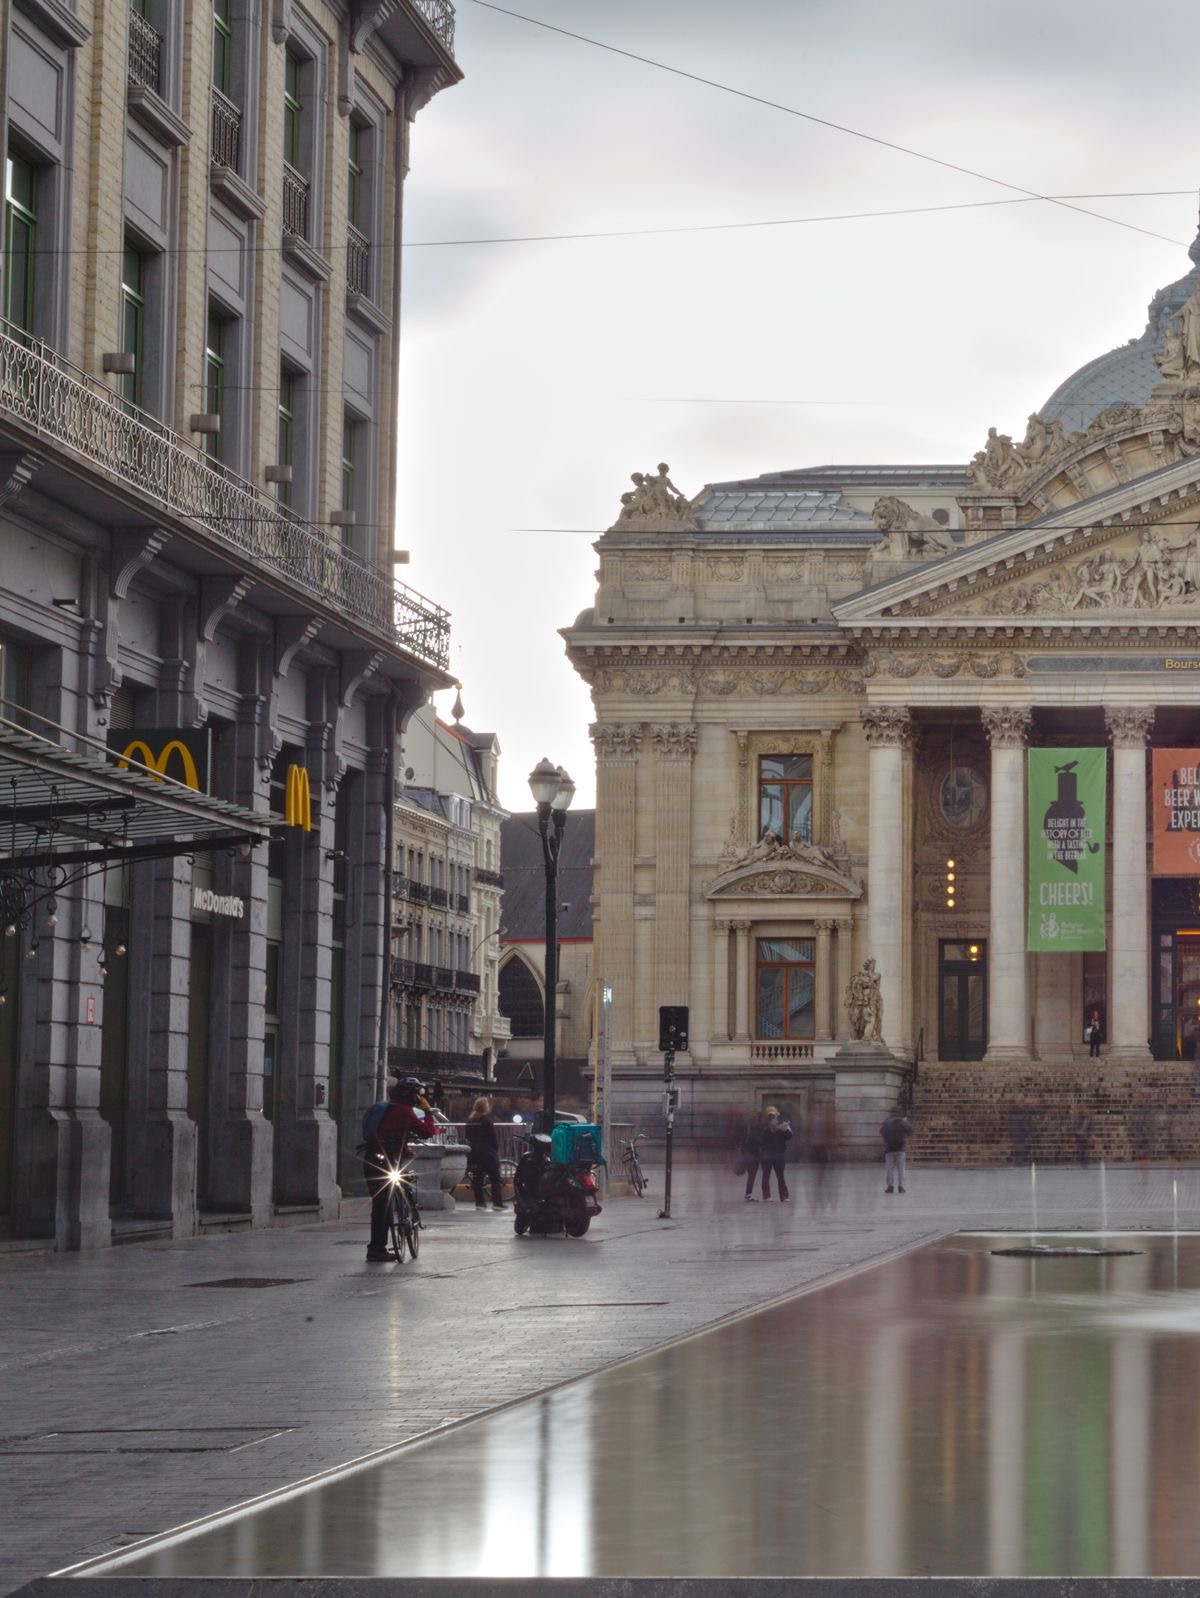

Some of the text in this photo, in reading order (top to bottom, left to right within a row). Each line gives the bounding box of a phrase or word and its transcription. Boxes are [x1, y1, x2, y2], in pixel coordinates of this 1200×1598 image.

[1164, 788, 1191, 806] BEER
[1068, 829, 1079, 839] OF
[1061, 840, 1066, 849] A
[193, 887, 244, 918] McDonald's
[1040, 882, 1093, 906] CHEERS!
